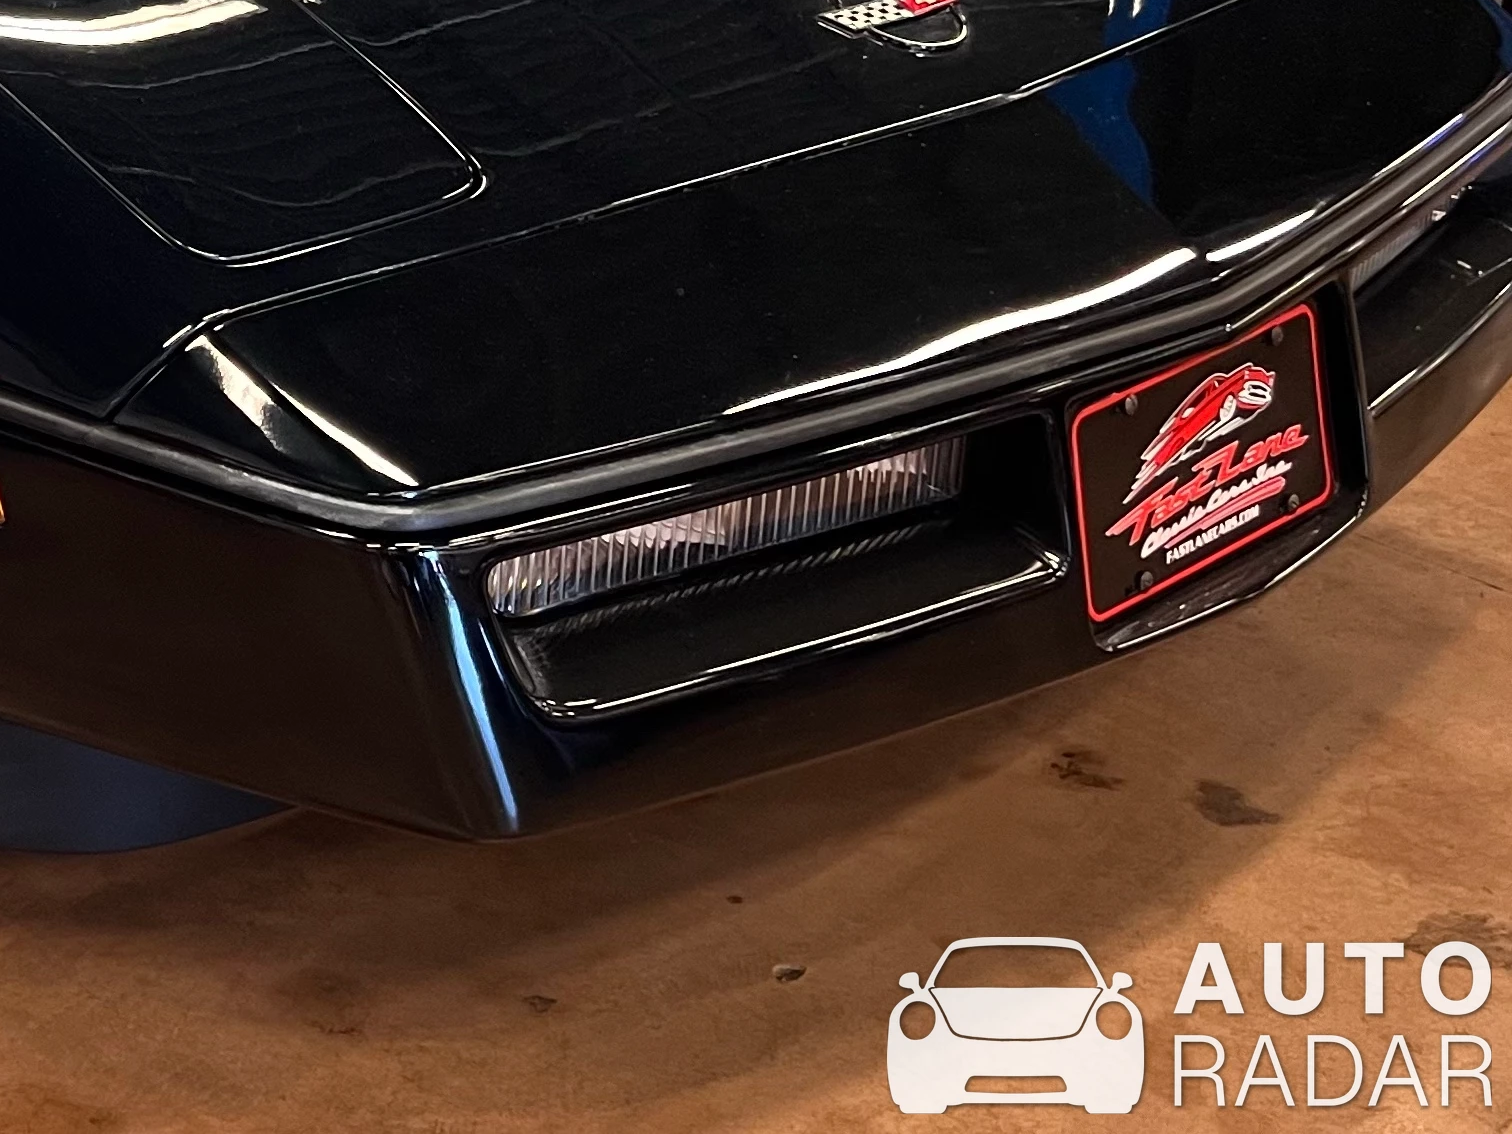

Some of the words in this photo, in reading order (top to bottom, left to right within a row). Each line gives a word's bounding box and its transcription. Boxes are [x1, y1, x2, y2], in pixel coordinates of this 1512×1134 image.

[1105, 472, 1216, 546] Fast
[1192, 424, 1309, 488] Lane
[1140, 505, 1206, 559] Classic
[1165, 504, 1260, 565] FASTLANECARS.COM
